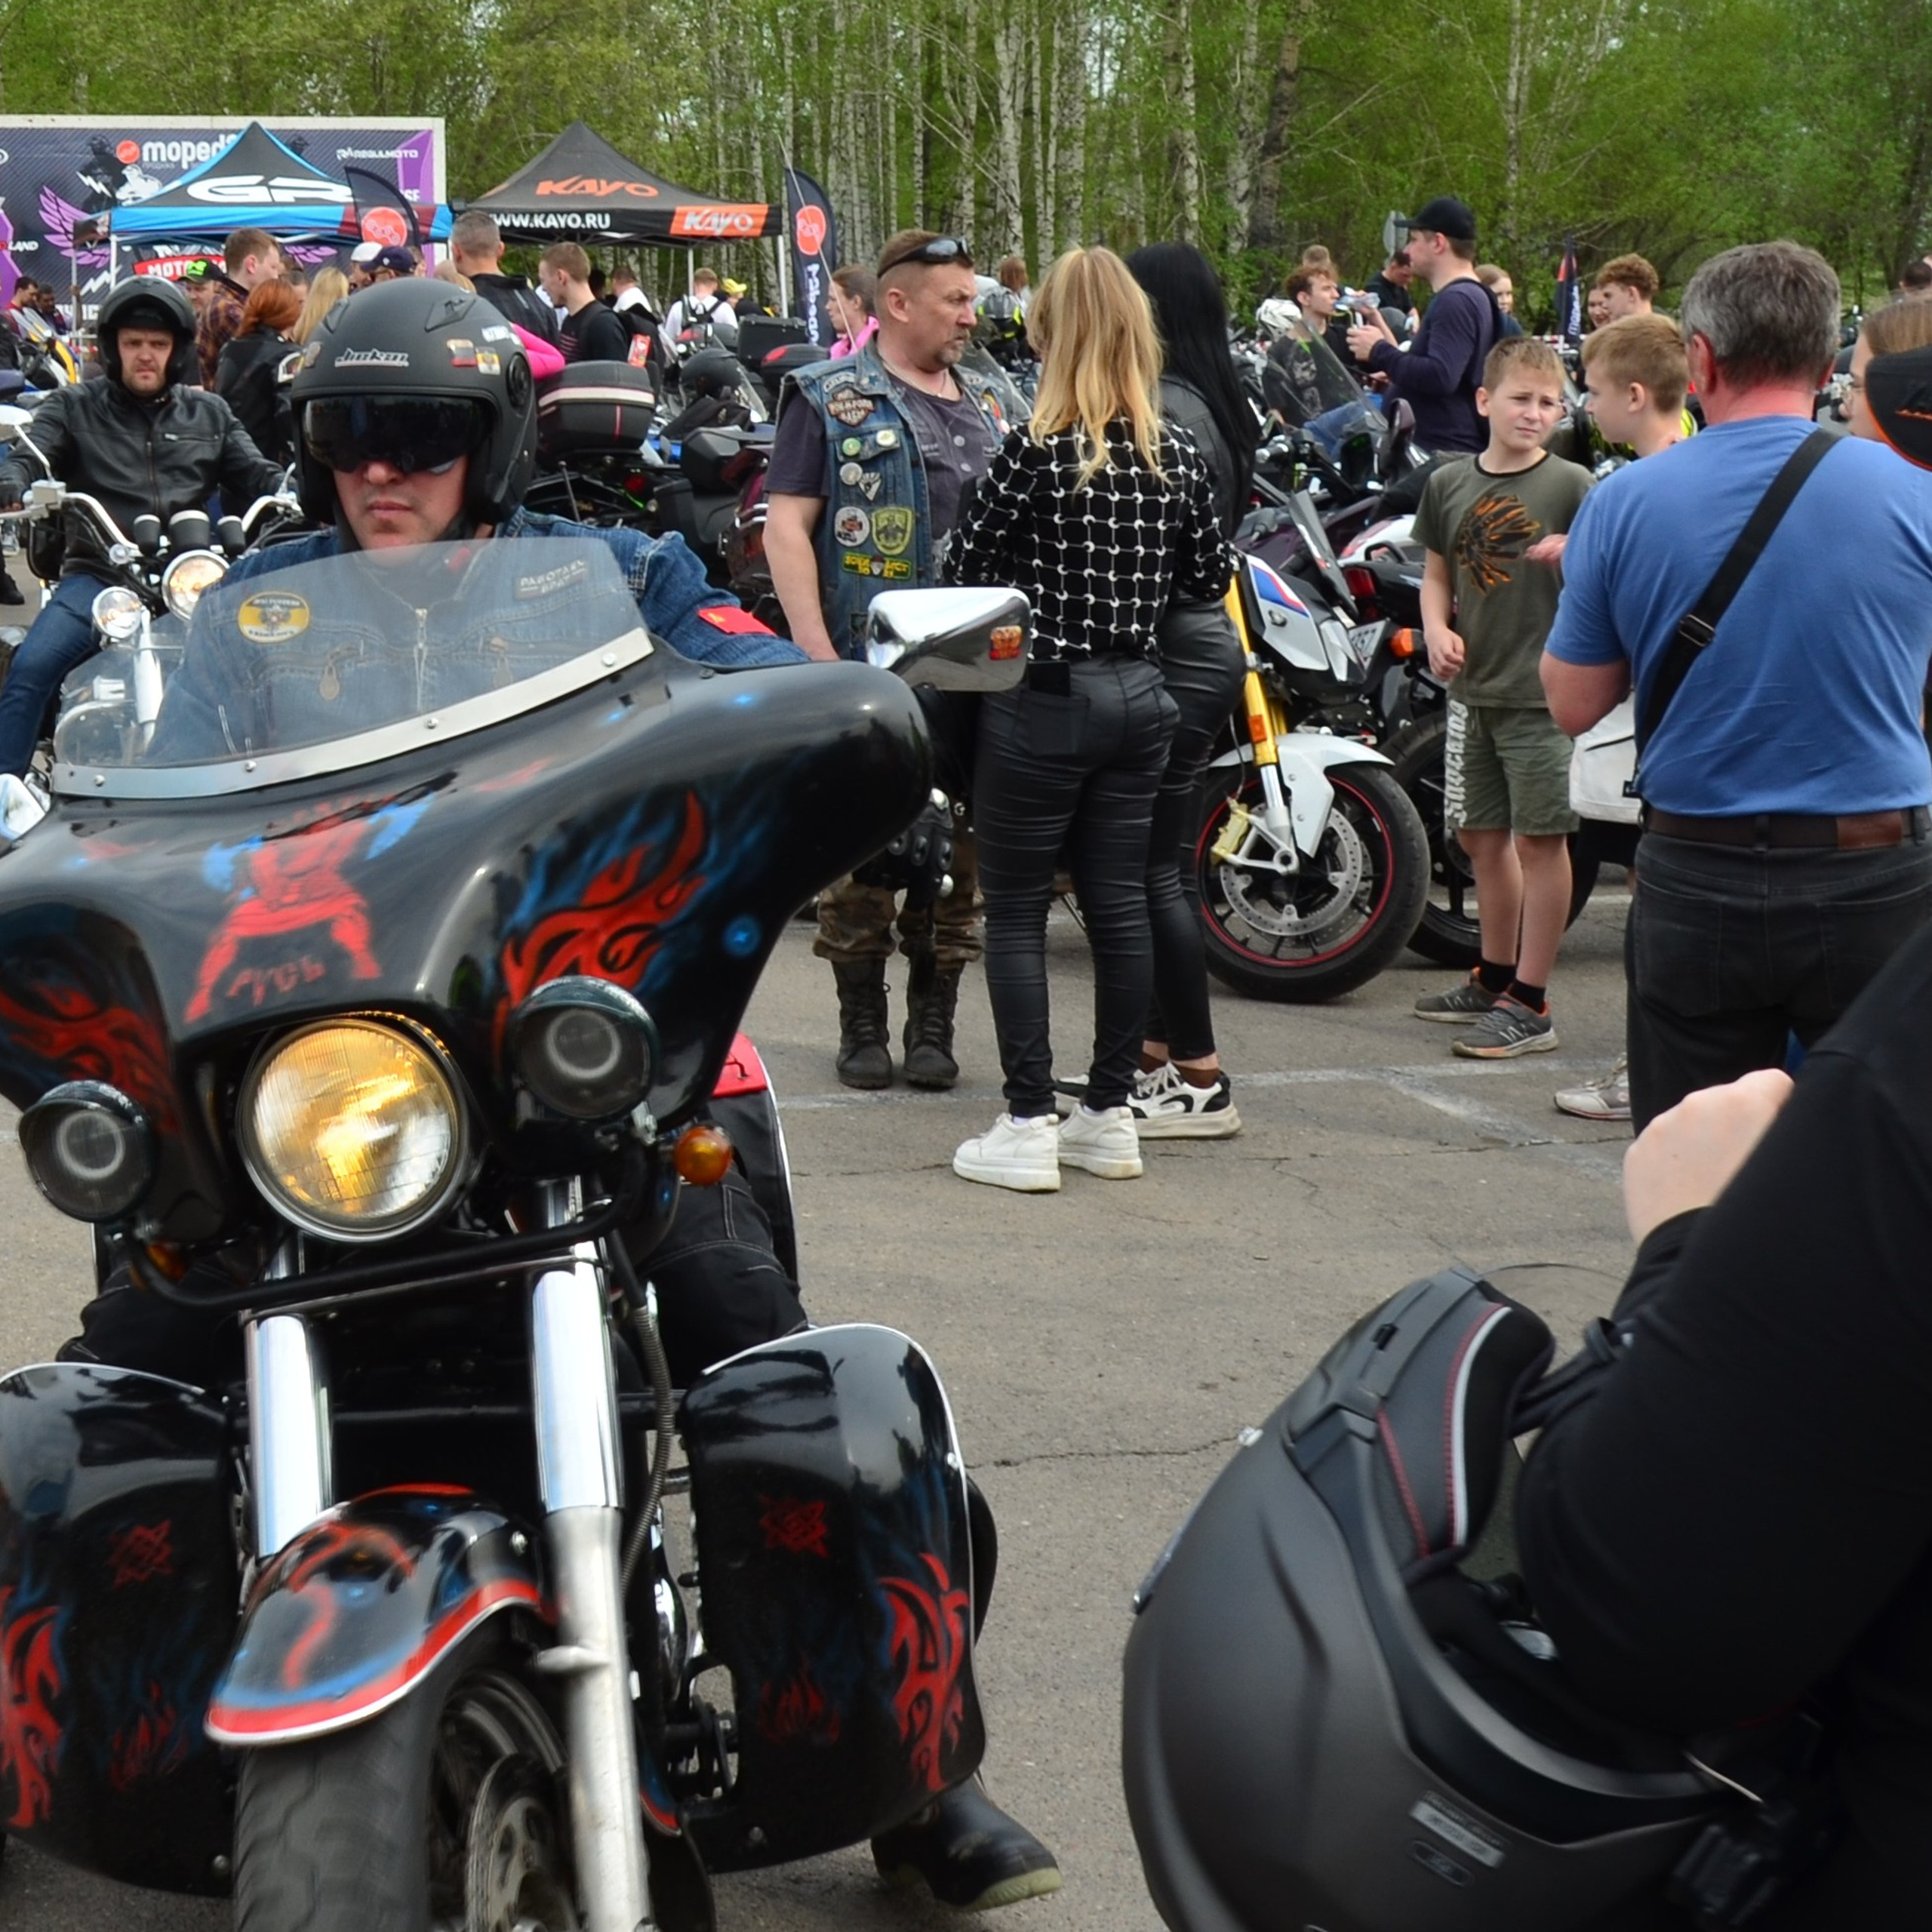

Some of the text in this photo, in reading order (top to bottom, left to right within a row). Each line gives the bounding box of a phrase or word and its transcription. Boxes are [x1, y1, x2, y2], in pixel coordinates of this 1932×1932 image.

[535, 175, 659, 198] KAYO
[490, 213, 611, 229] WW.KAYO.RU
[684, 209, 753, 235] KAYO
